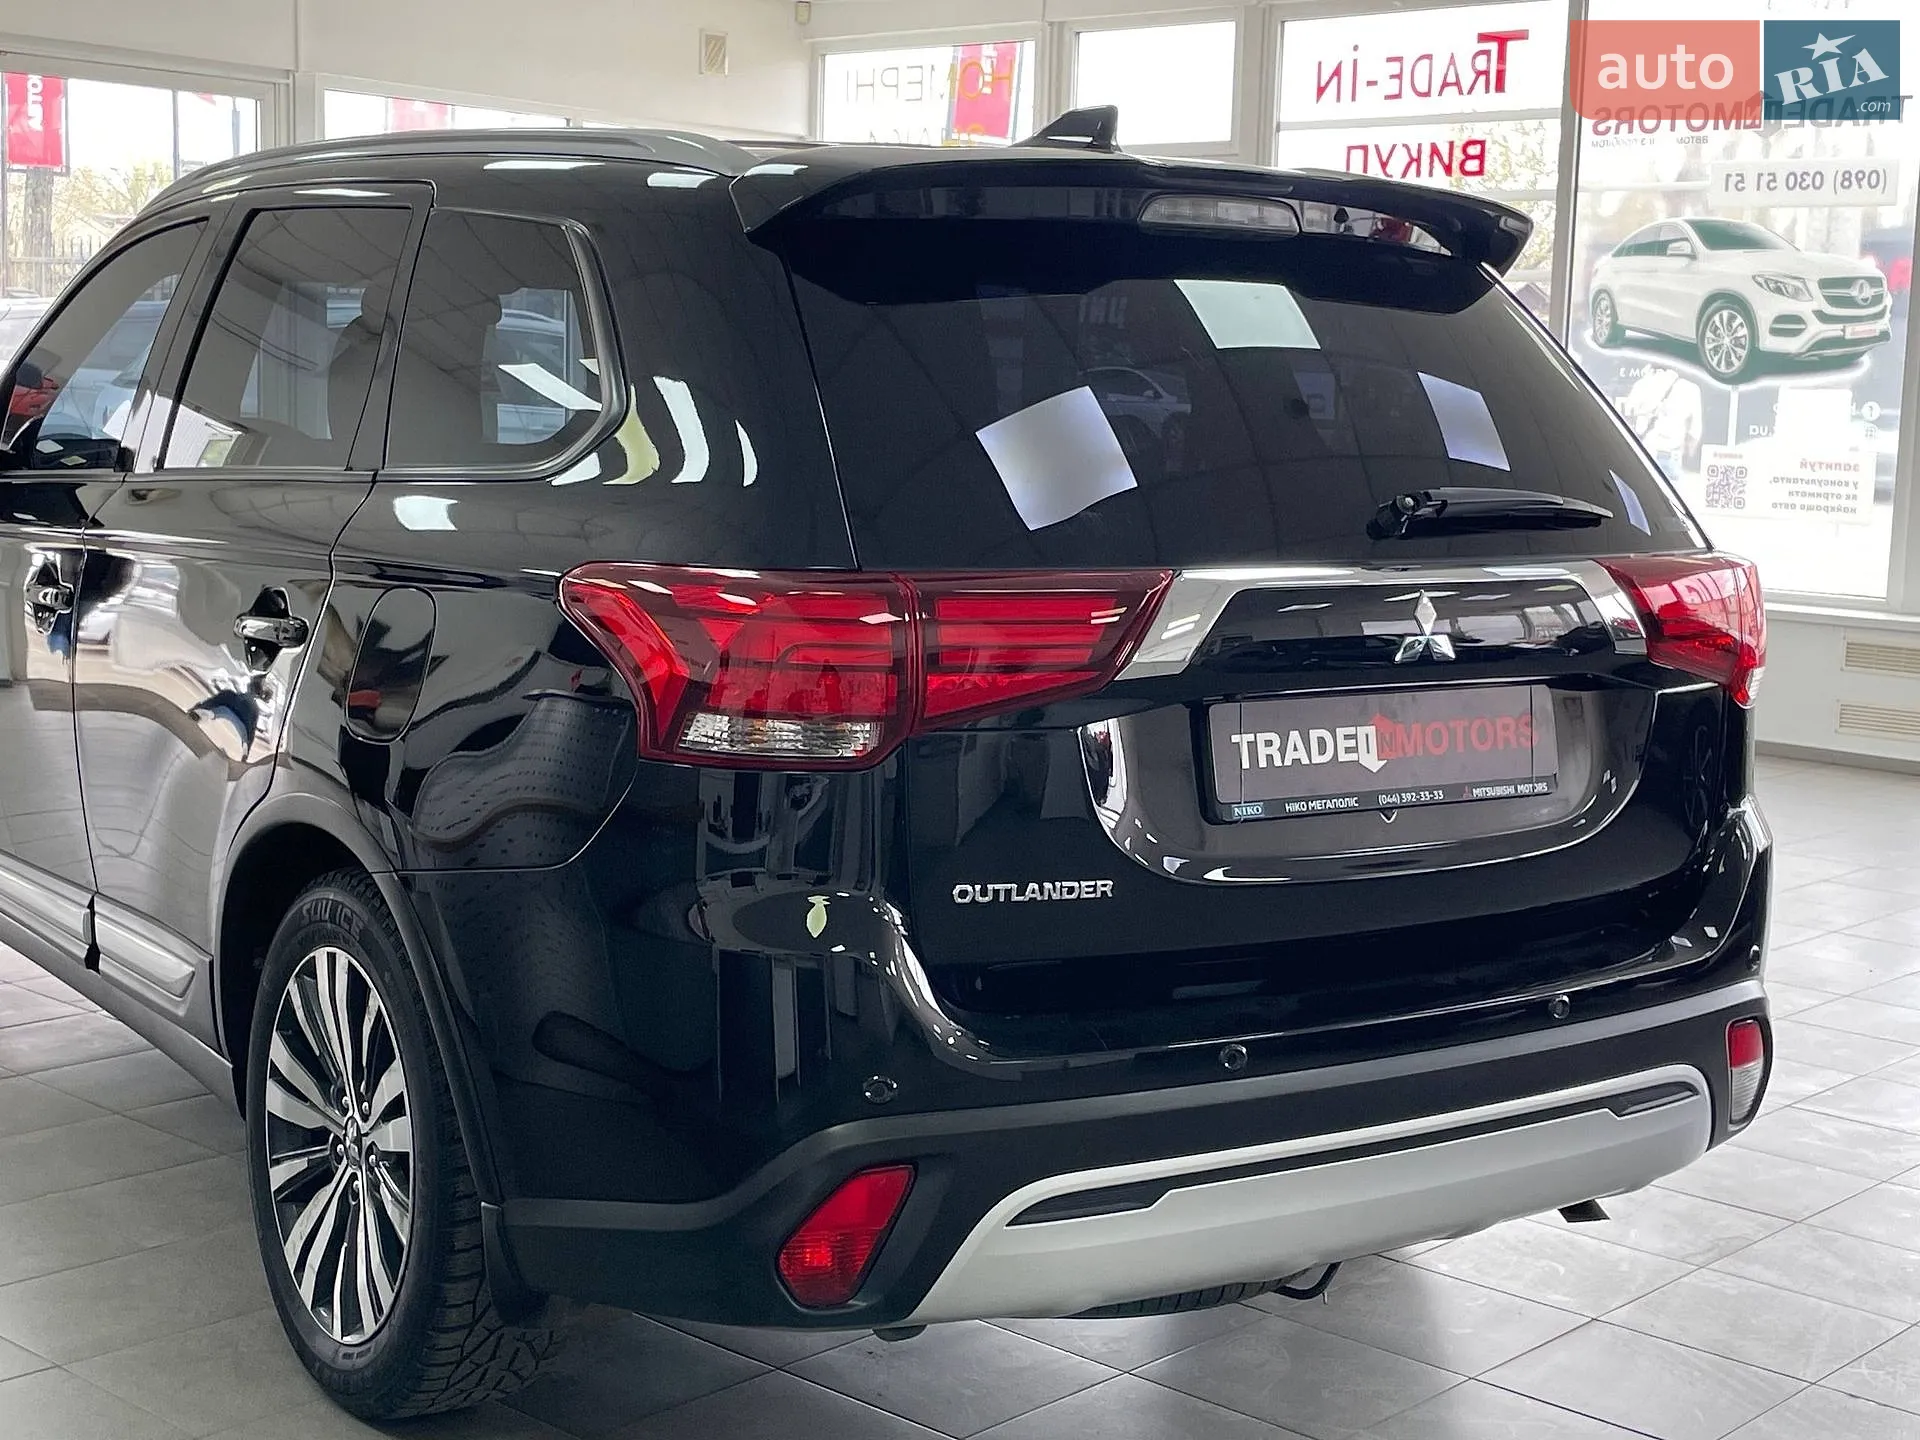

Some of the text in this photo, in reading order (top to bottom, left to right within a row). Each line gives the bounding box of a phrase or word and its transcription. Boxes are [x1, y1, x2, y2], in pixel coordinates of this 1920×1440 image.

[1401, 790, 1444, 803] 392-33-33
[1233, 804, 1263, 817] NIKO
[952, 879, 1114, 904] OUTLANDER
